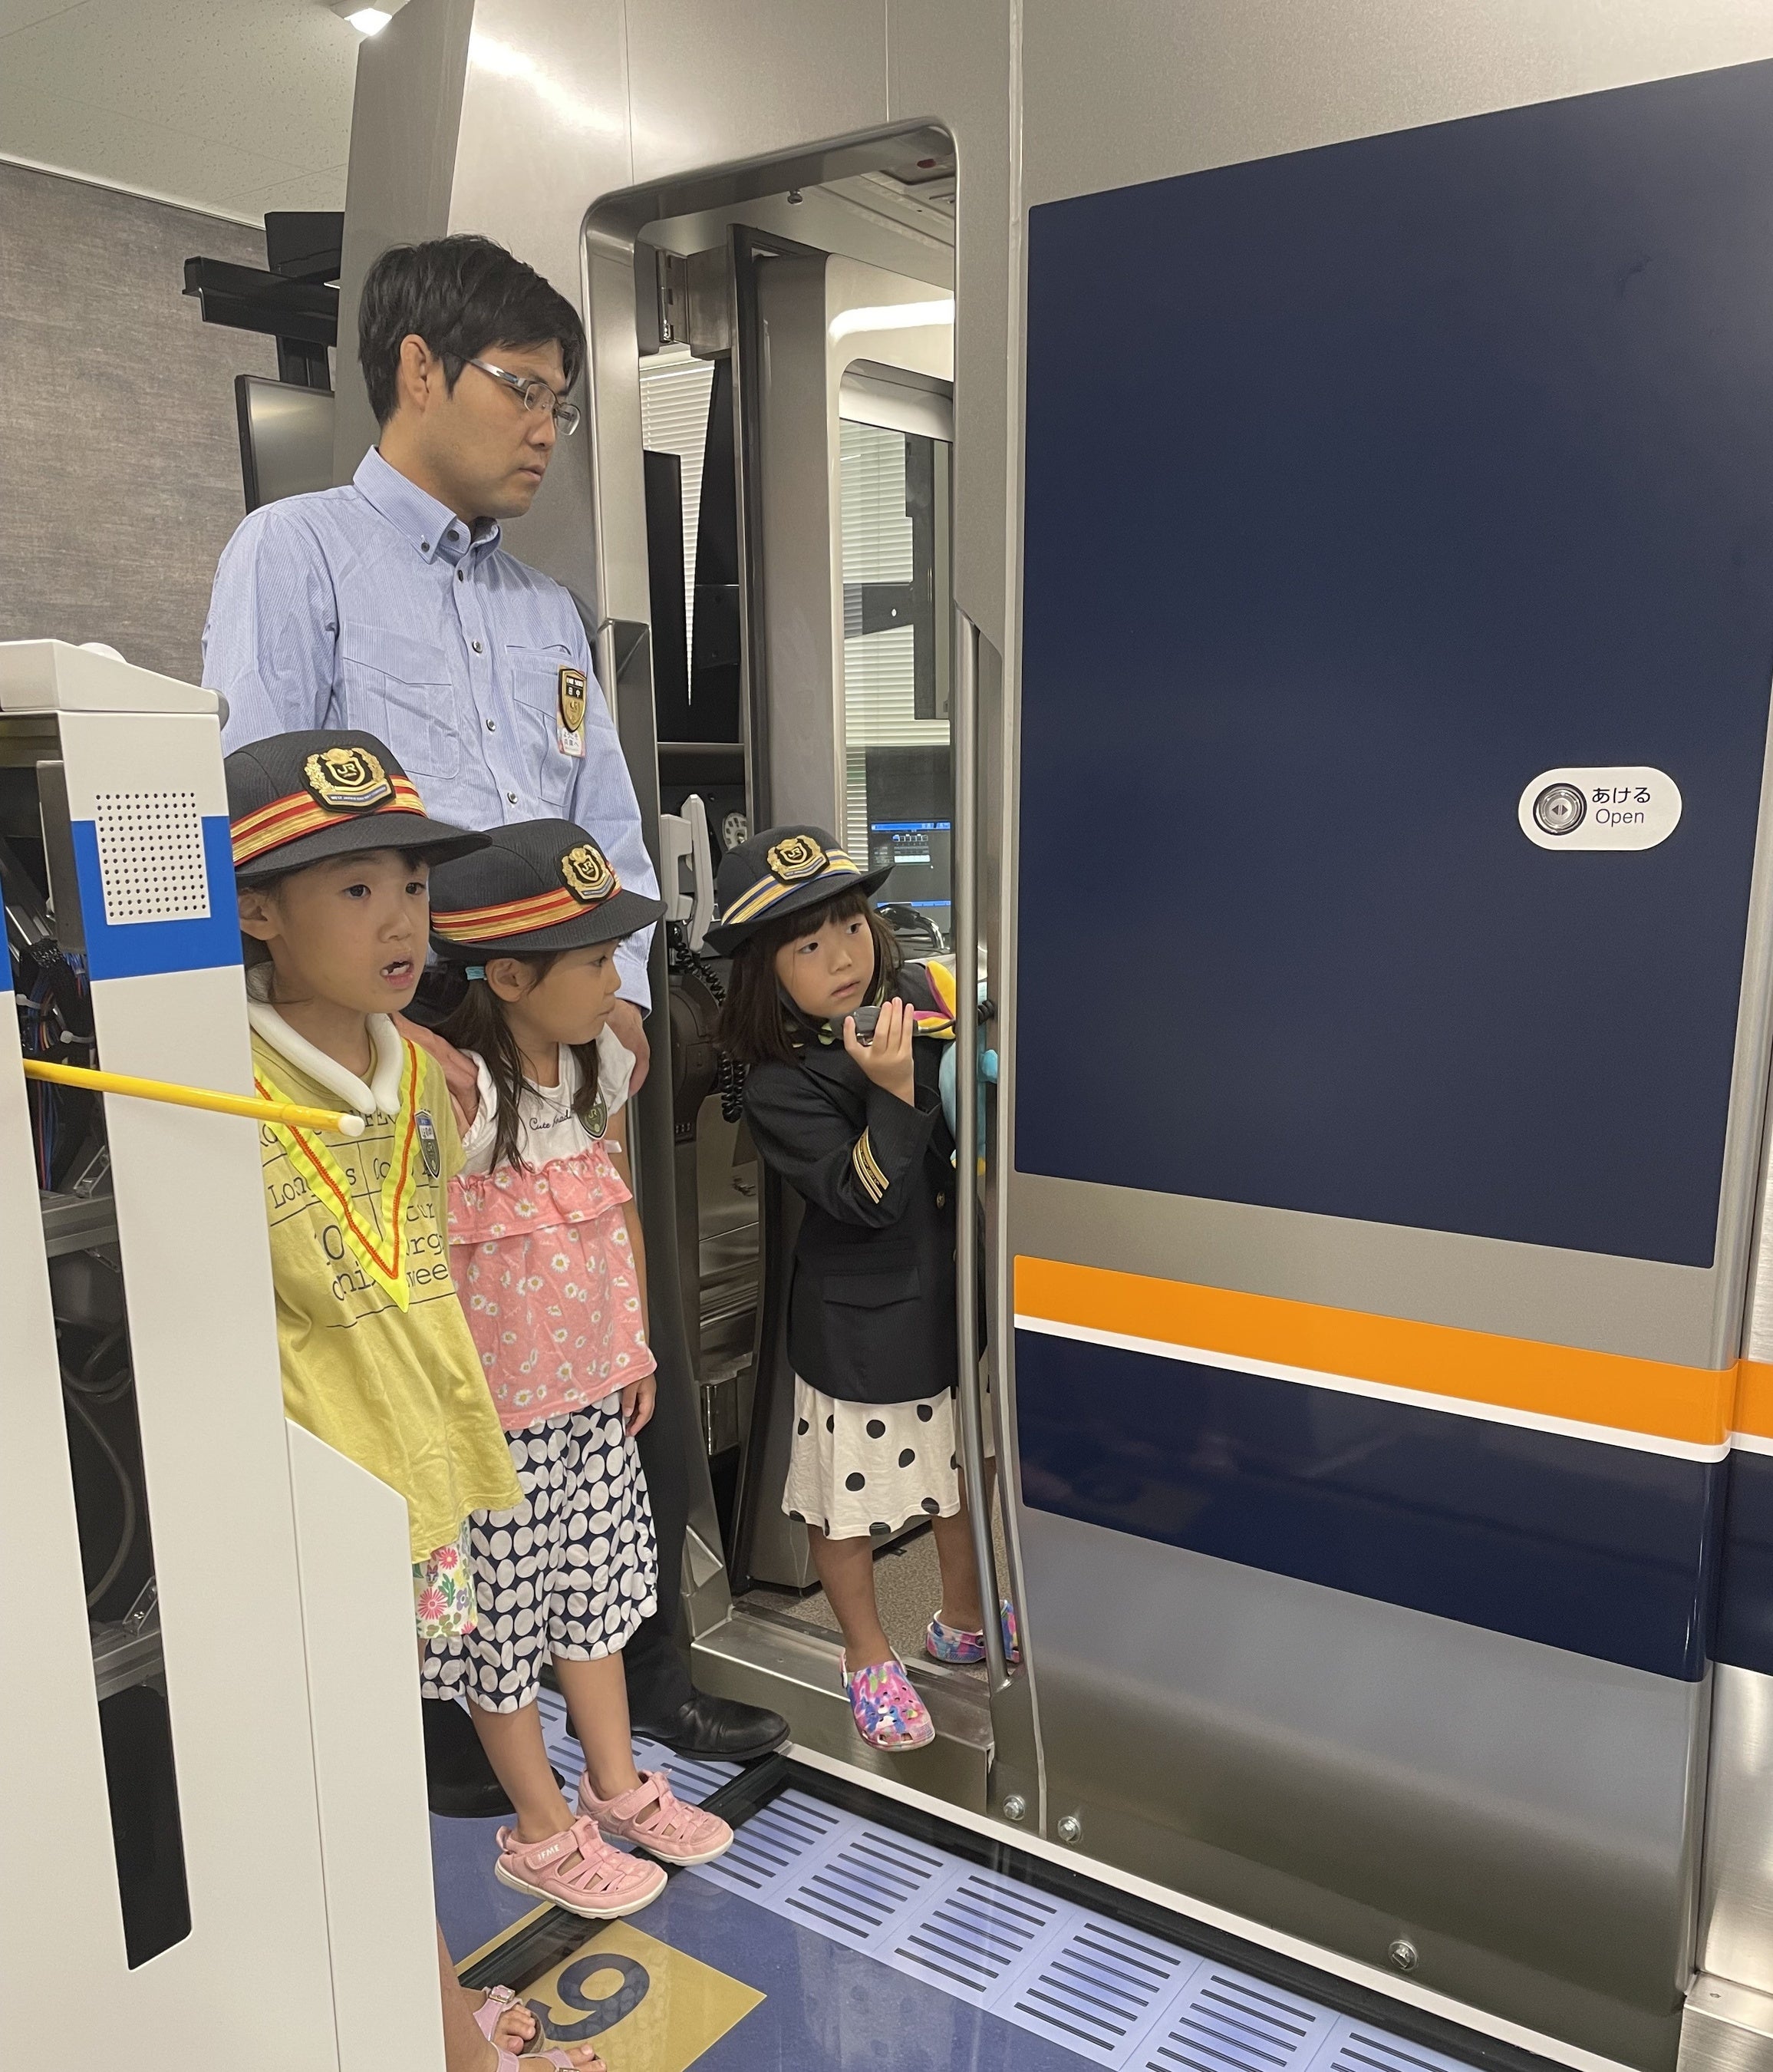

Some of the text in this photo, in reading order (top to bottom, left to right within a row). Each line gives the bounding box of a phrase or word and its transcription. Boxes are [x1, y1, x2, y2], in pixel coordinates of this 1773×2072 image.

[337, 763, 357, 774] JR
[1592, 787, 1651, 804] あける
[1596, 808, 1644, 827] Open
[538, 1843, 560, 1861] IFME
